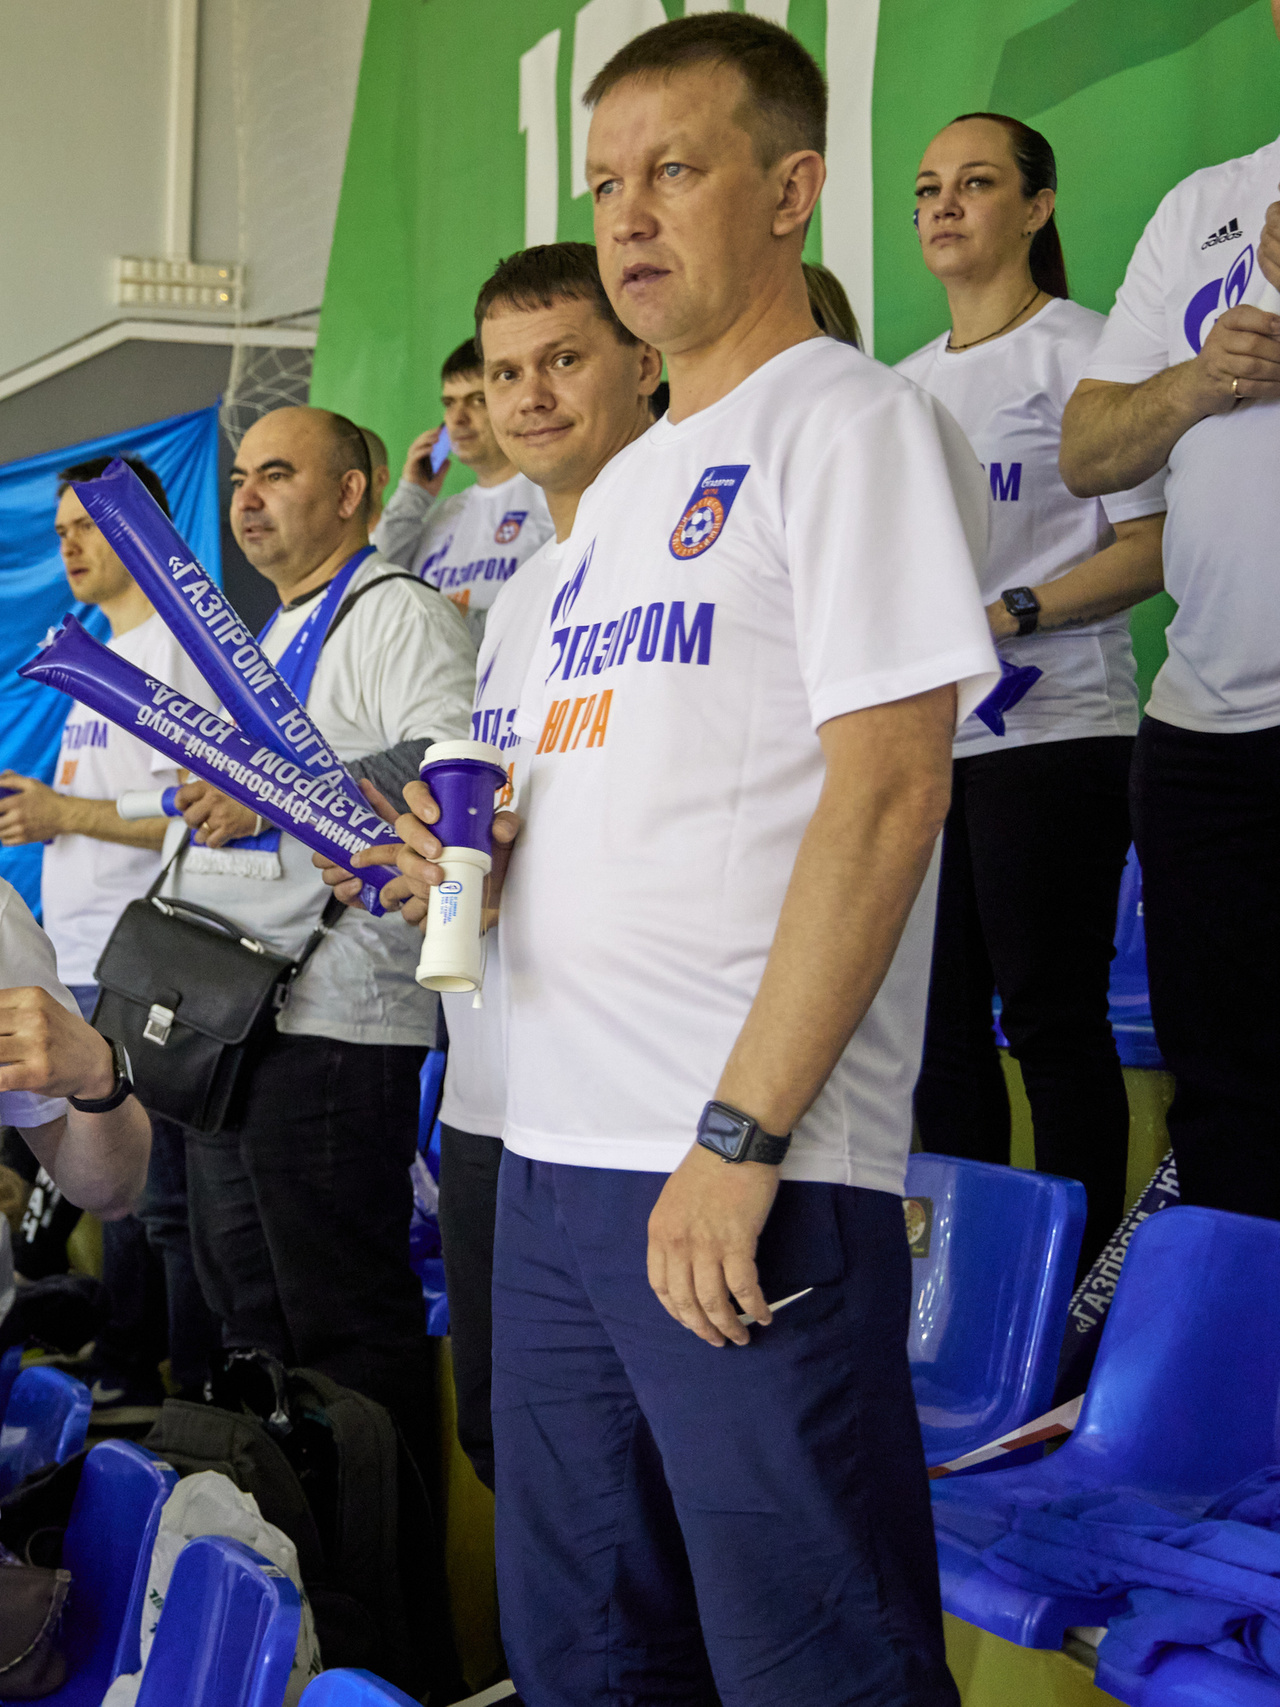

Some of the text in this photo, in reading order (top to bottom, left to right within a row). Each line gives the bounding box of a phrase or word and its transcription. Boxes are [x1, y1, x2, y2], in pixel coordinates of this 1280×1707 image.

[1201, 230, 1243, 250] adidas
[169, 555, 277, 695] «ГАЗПРОМ
[135, 704, 189, 743] клуб
[535, 688, 614, 756] ЮГРА
